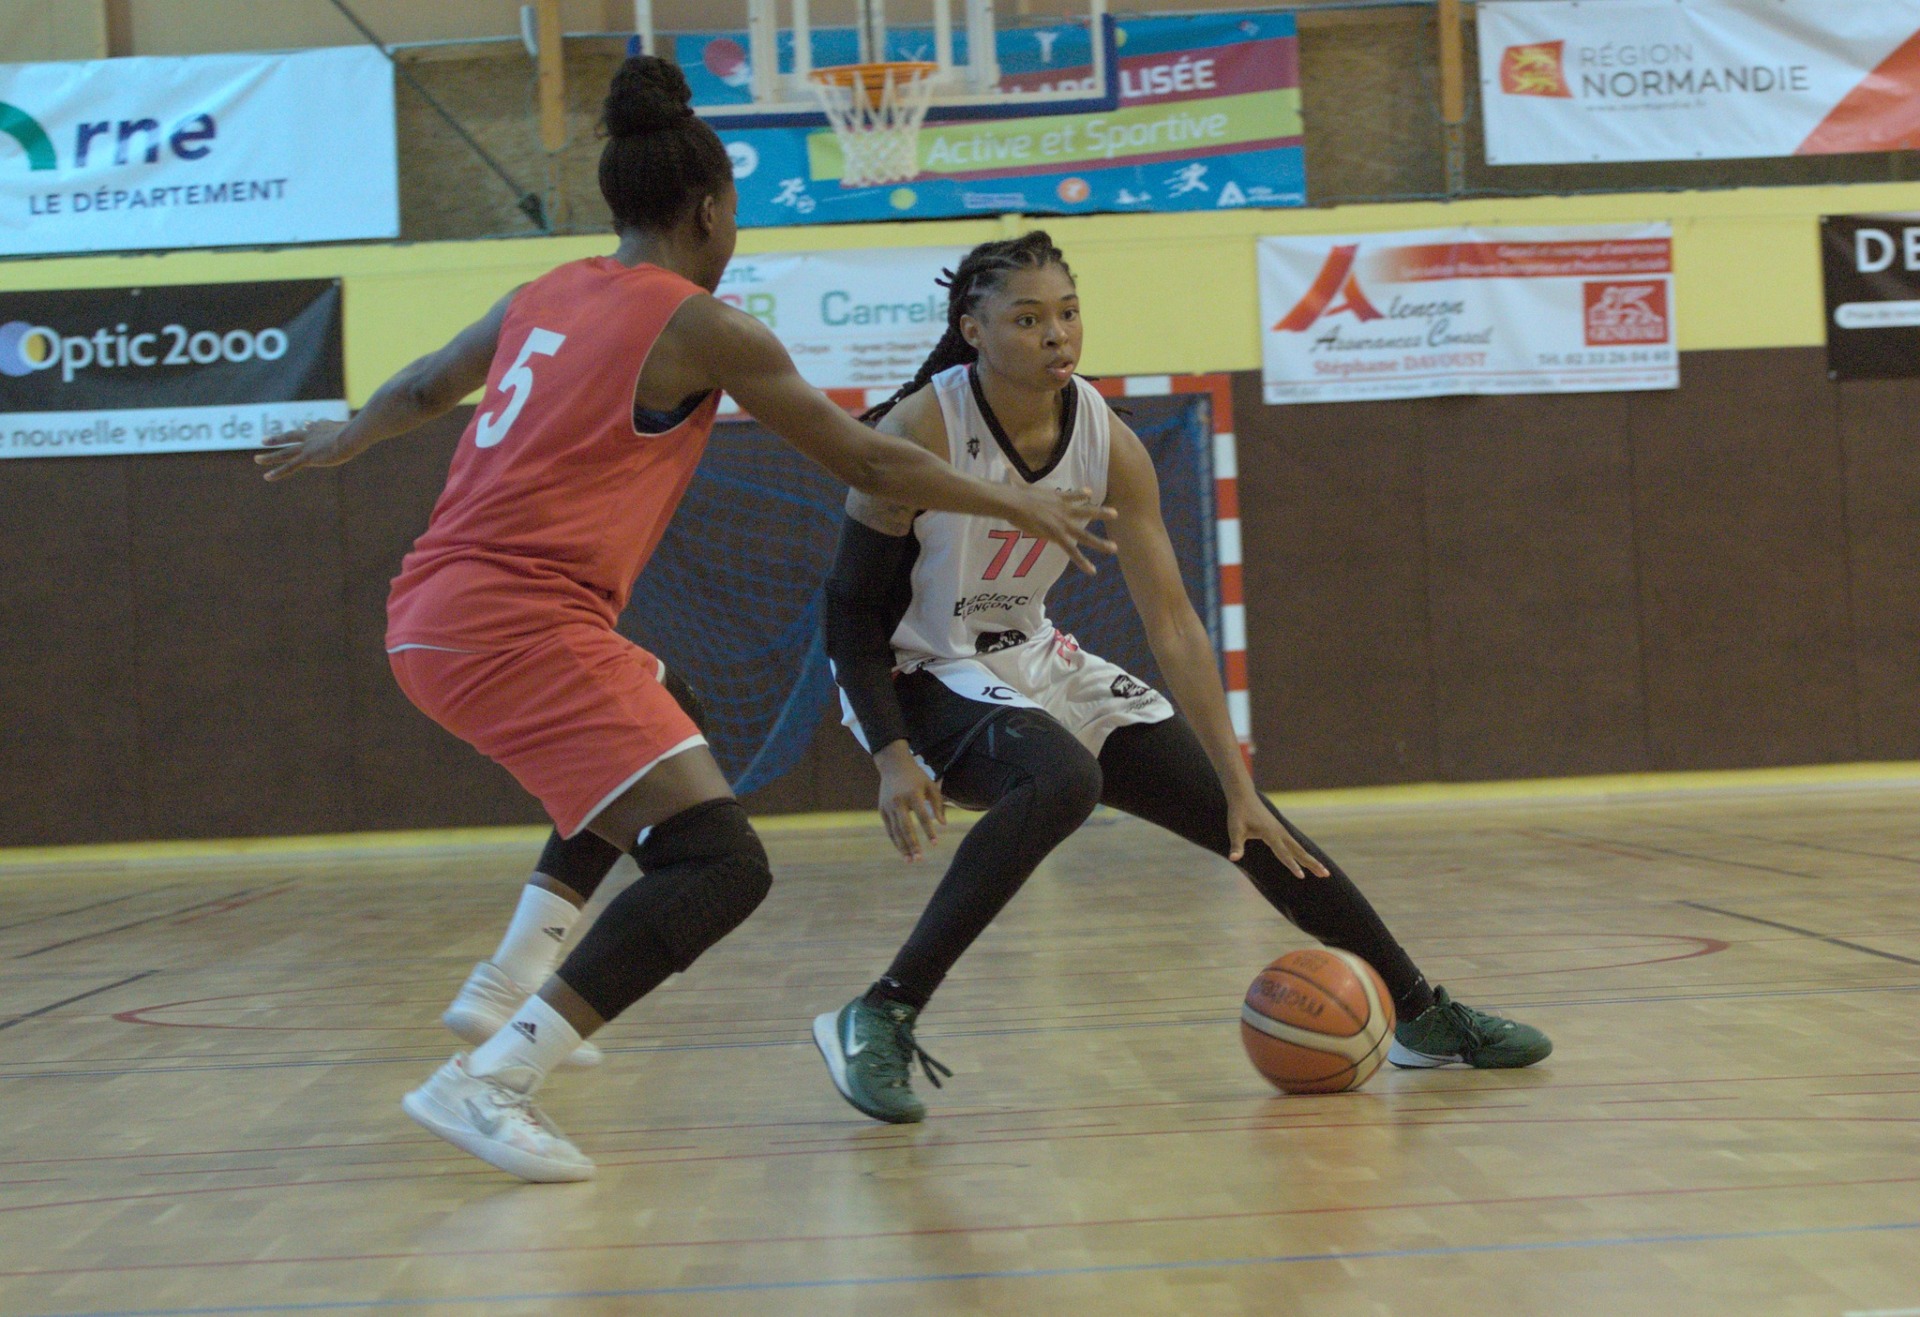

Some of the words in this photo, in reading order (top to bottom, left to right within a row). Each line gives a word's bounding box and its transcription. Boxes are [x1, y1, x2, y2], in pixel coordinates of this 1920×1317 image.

[1580, 43, 1694, 68] RÉGION
[1582, 65, 1811, 98] NORMANDIE
[925, 133, 1032, 165] Active
[1040, 124, 1076, 155] et
[1086, 112, 1228, 158] Sportive
[29, 195, 62, 215] LE
[73, 178, 288, 213] DÉPARTEMENT
[819, 290, 950, 327] Carrela
[474, 326, 567, 449] 5
[11, 419, 126, 448] nouvelle
[135, 420, 212, 447] vision
[219, 414, 251, 440] de
[981, 529, 1049, 580] 77
